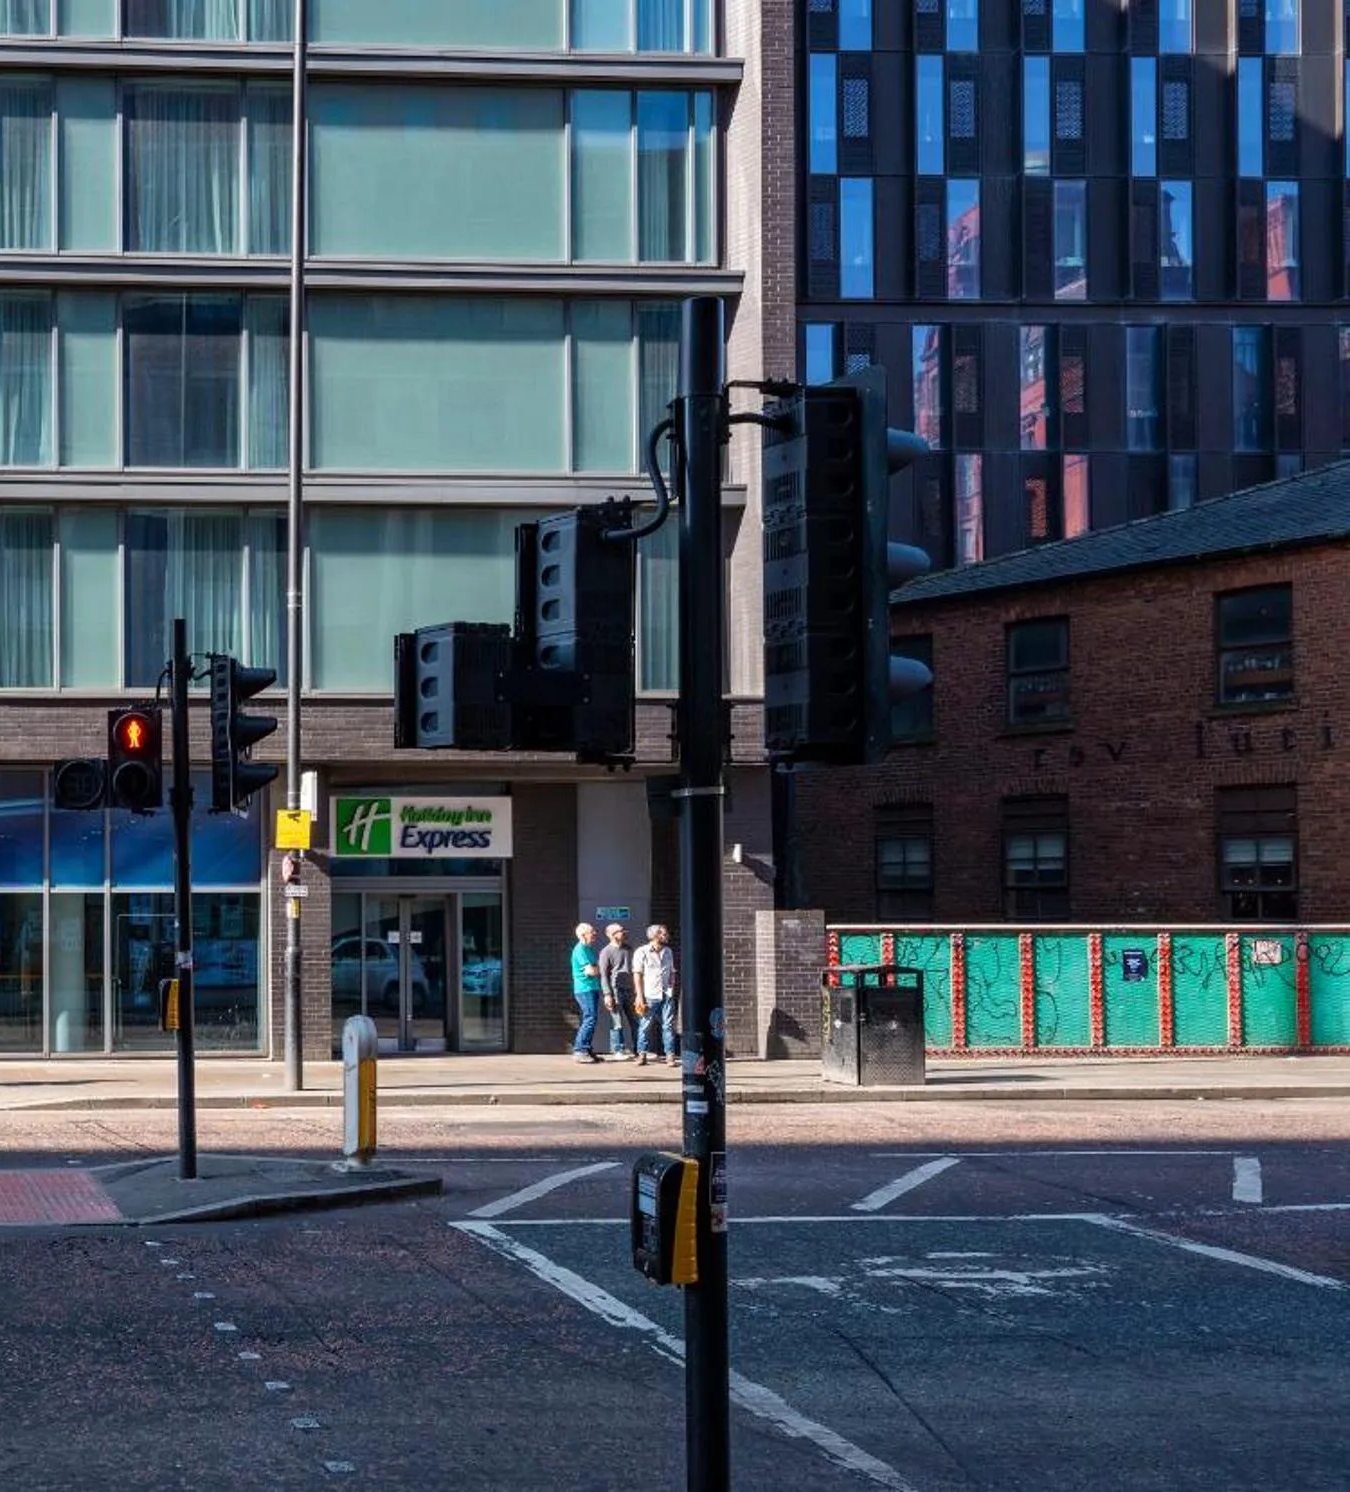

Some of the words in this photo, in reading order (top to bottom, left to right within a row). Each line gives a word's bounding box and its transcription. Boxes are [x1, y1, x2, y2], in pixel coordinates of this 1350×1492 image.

[399, 805, 464, 826] Holiday
[465, 805, 493, 823] Inn
[399, 825, 493, 854] Express
